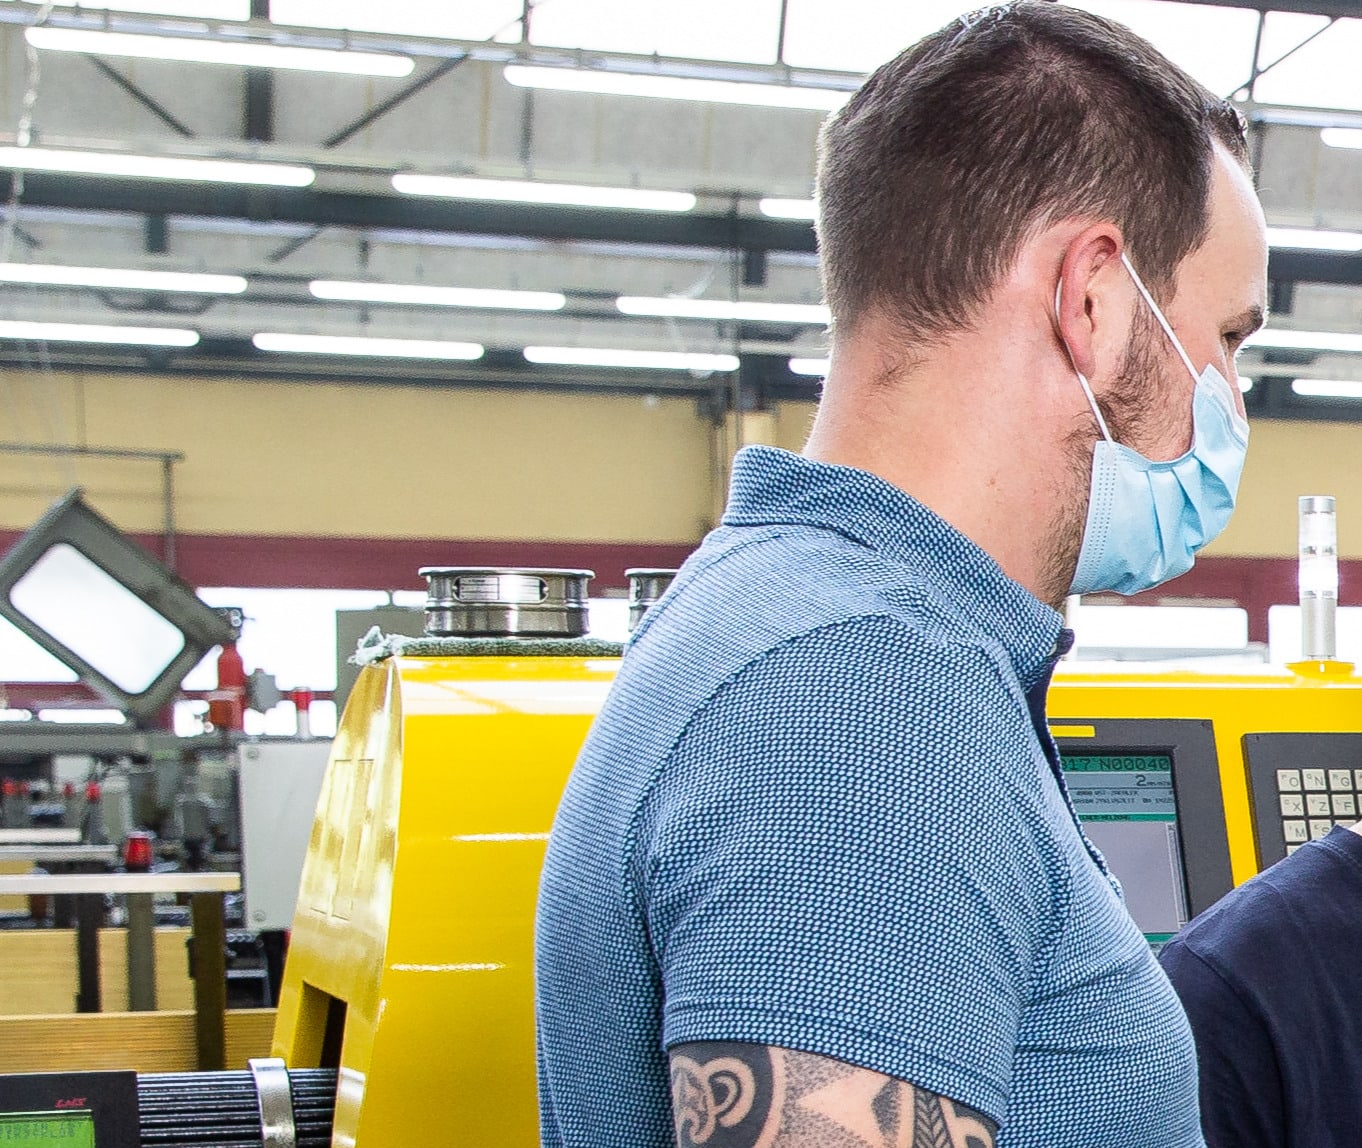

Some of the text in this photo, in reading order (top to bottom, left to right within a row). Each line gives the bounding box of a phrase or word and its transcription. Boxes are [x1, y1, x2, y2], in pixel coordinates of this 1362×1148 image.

[1314, 776, 1324, 787] N
[1340, 776, 1350, 787] G
[1292, 802, 1302, 812] X
[1318, 801, 1328, 812] Z
[1343, 801, 1352, 812] F
